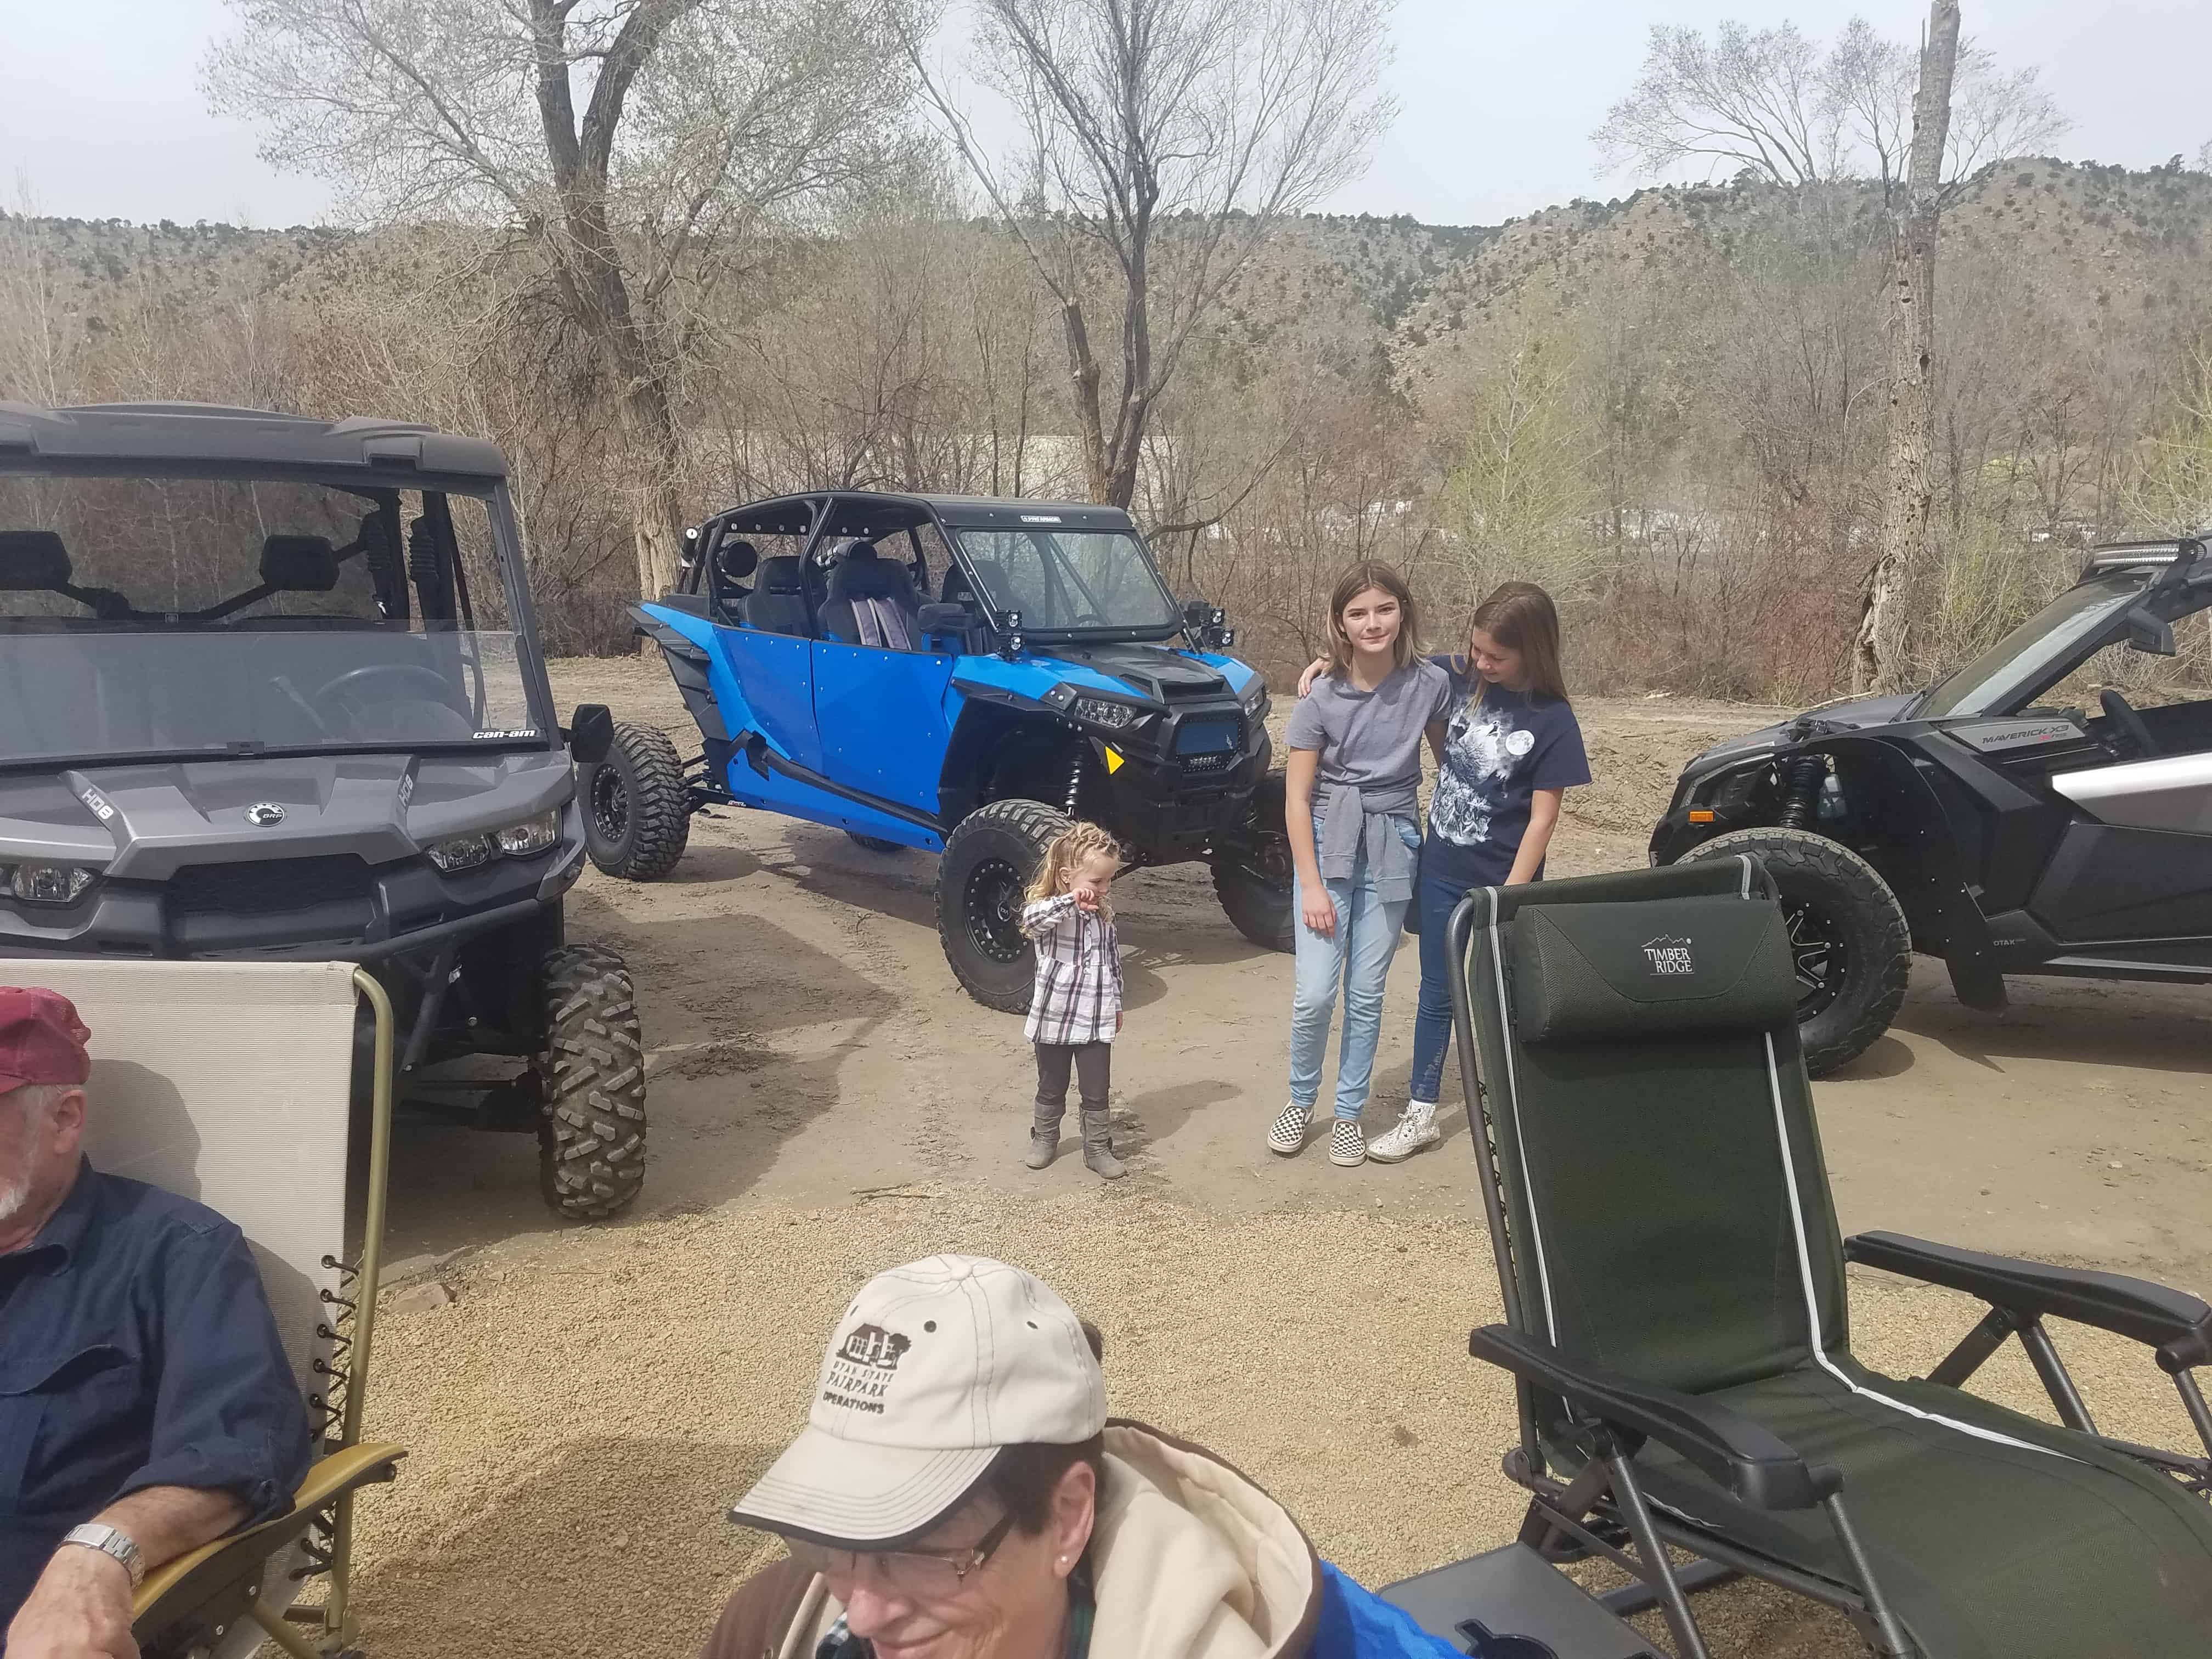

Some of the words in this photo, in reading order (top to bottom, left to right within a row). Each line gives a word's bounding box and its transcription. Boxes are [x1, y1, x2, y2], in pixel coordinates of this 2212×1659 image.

[472, 730, 535, 740] can-am
[1982, 728, 2047, 743] MAVERICK
[2050, 725, 2069, 733] X3
[82, 789, 114, 819] HD8
[1644, 947, 1691, 961] TIMBER
[1655, 960, 1692, 973] RIDGE
[826, 1371, 888, 1397] FAIRPARK
[823, 1391, 884, 1414] OPERATIONS
